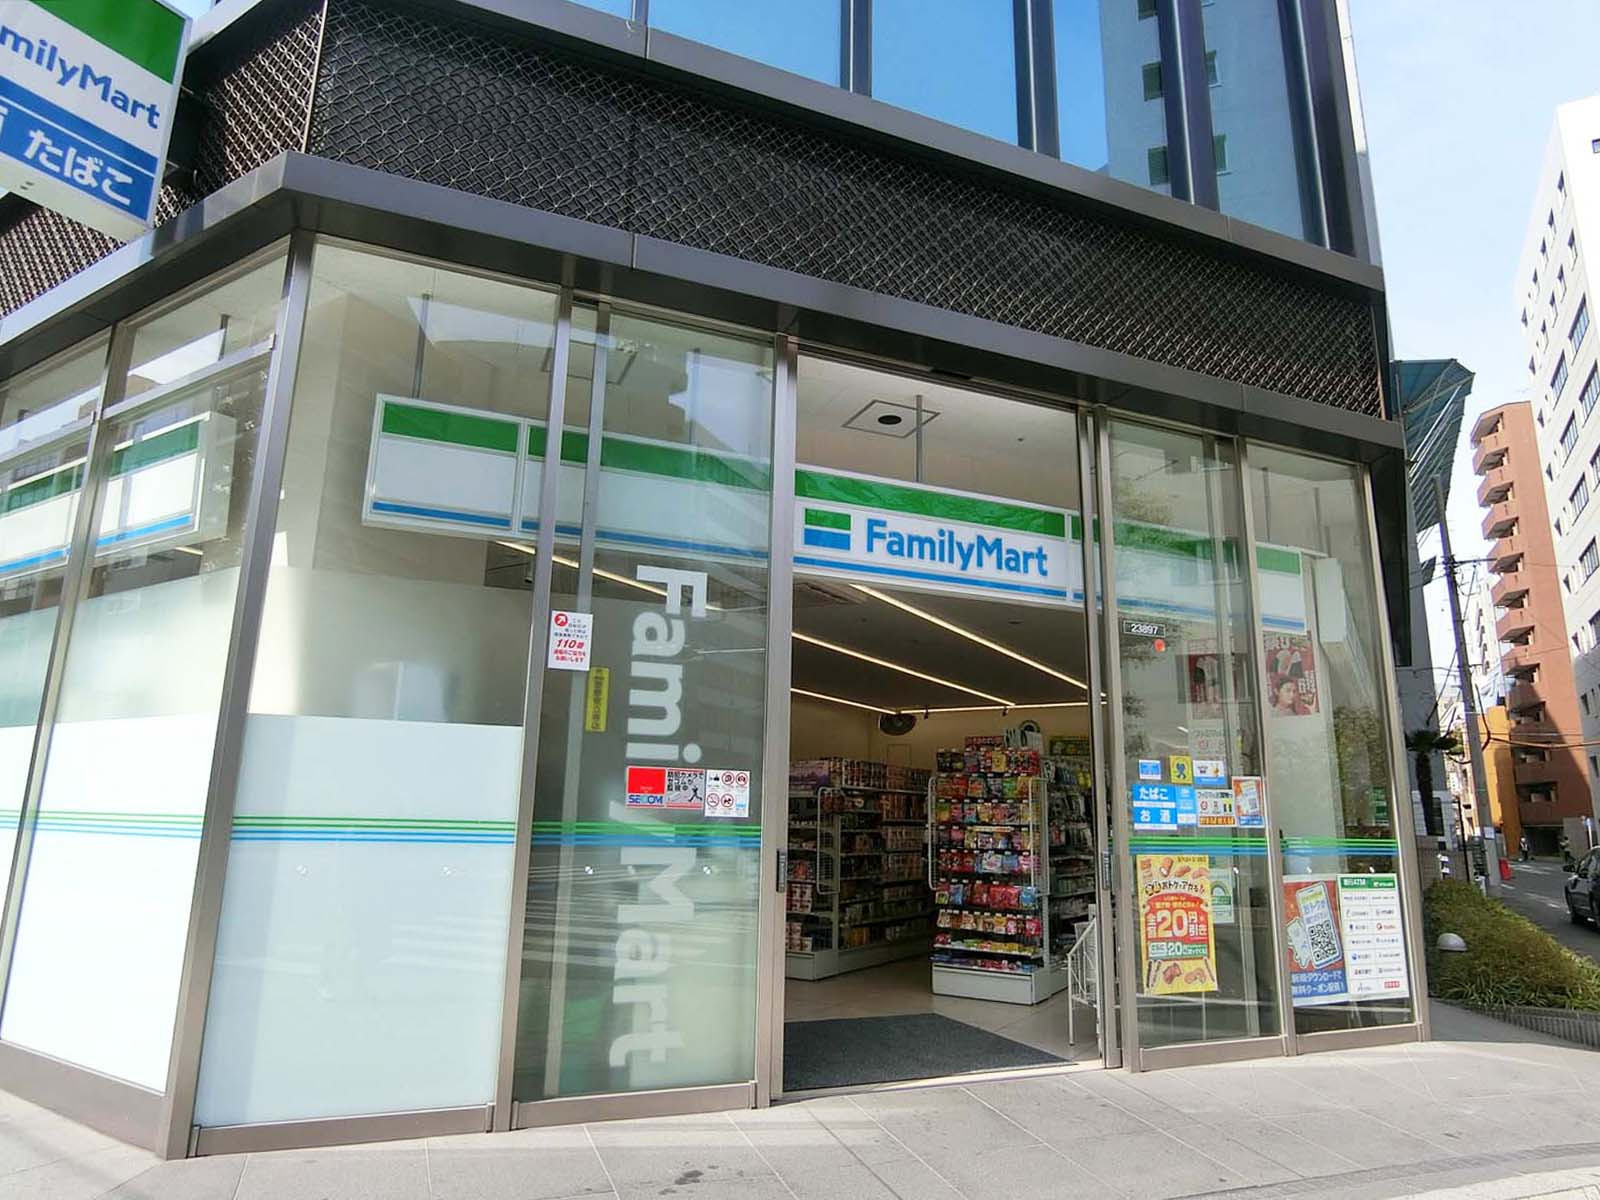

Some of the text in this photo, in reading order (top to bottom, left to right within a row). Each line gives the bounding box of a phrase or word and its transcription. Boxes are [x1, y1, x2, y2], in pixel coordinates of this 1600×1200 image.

[24, 129, 133, 206] たばこ
[866, 518, 1048, 576] FamilyMart
[609, 565, 708, 1067] Fami Mart
[1139, 787, 1169, 800] たばこ
[1156, 908, 1190, 938] 20
